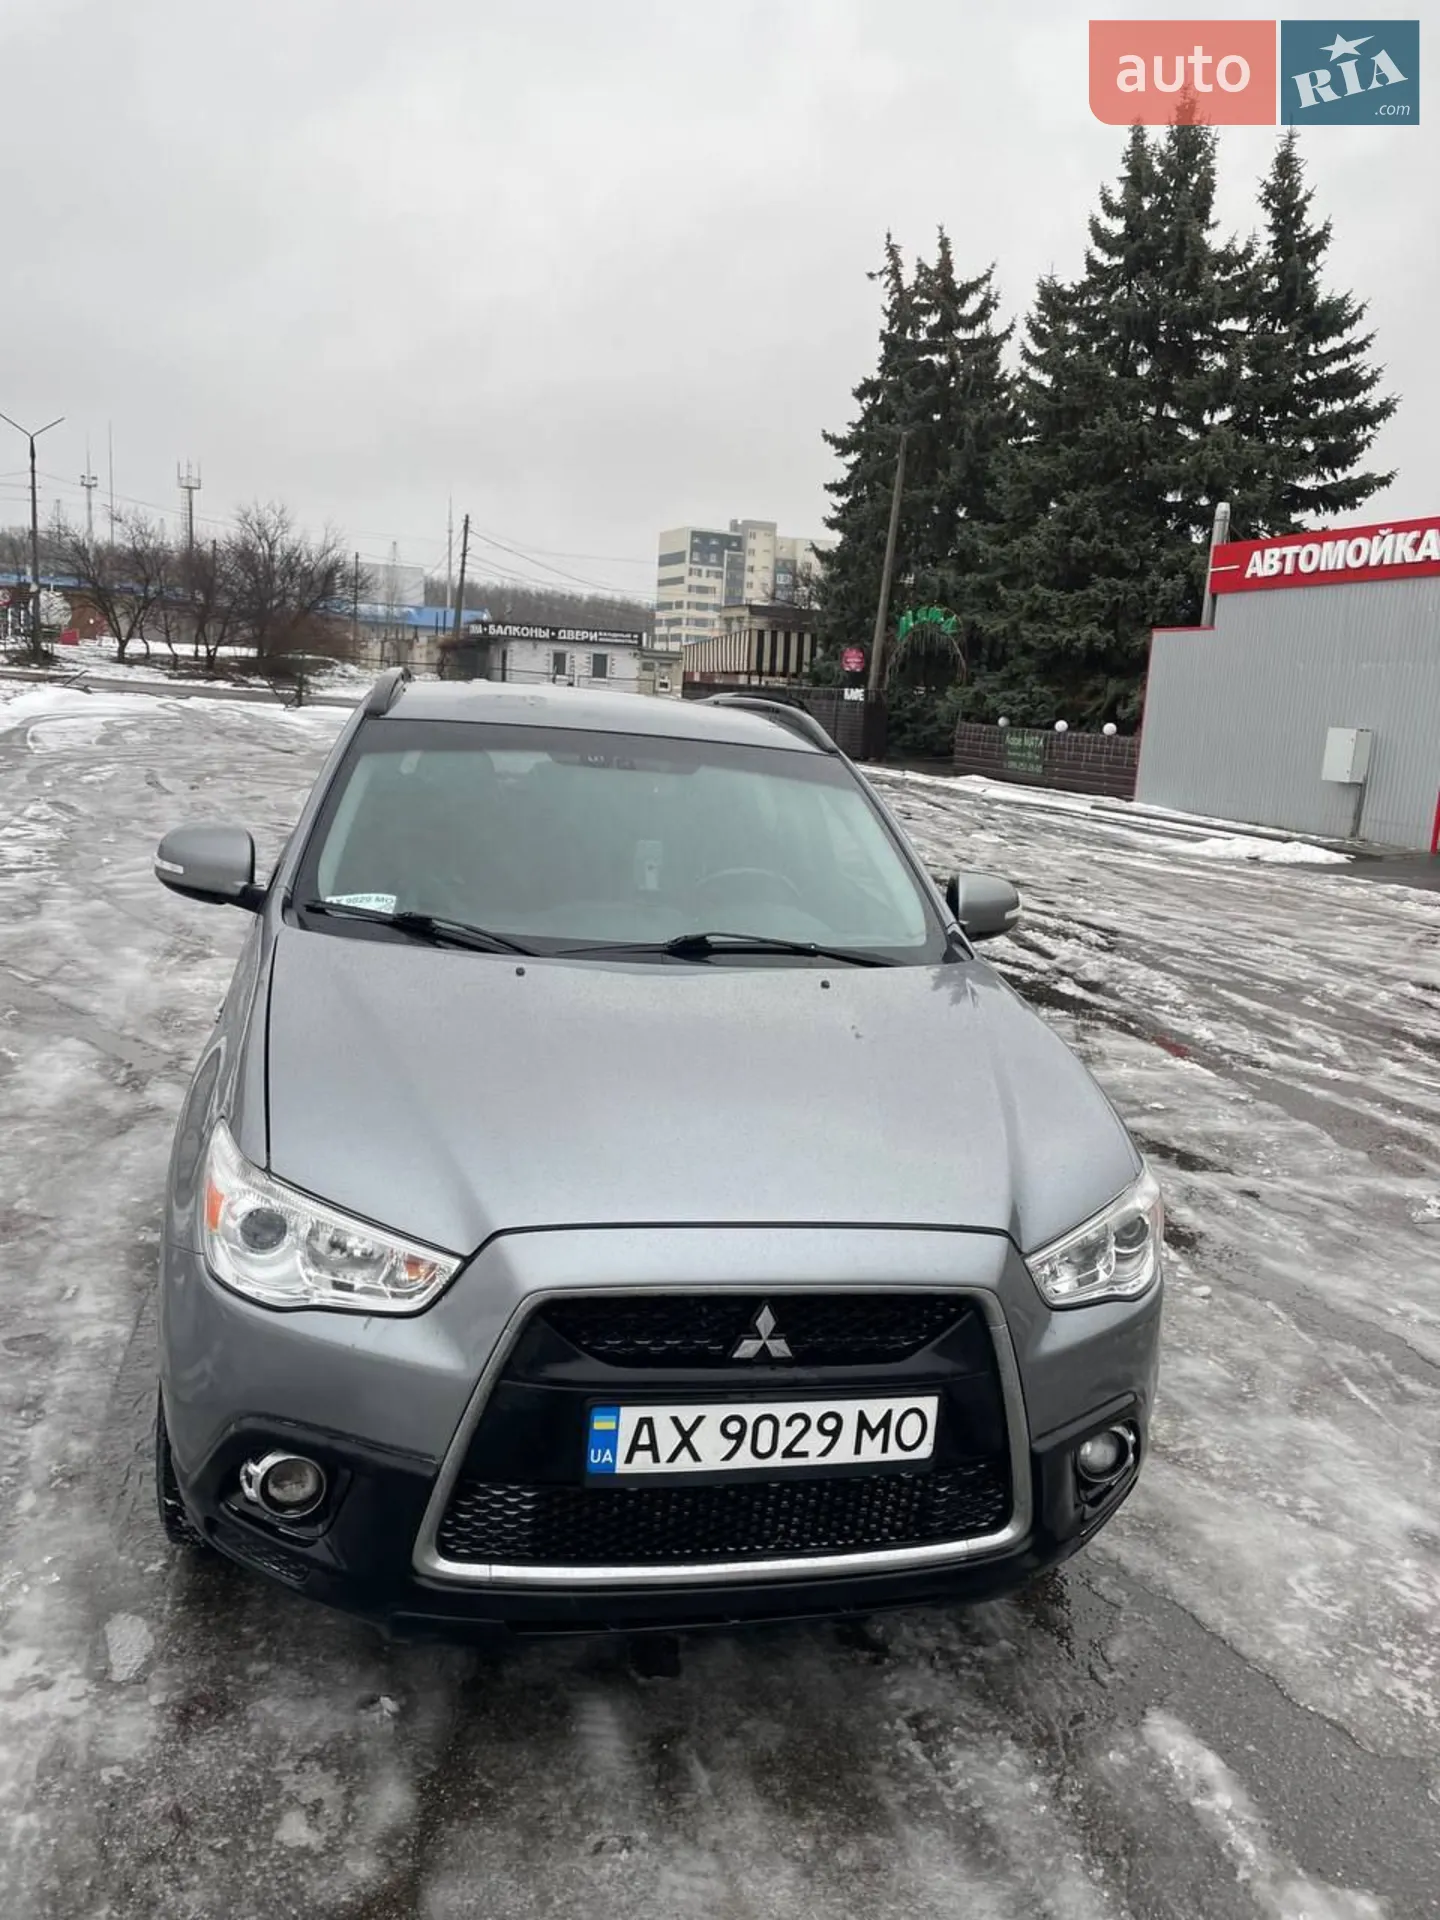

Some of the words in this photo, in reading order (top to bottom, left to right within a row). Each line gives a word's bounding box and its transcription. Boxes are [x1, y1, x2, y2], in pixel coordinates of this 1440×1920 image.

[1245, 528, 1440, 579] АВТОМОЙКА
[488, 624, 550, 639] БАЛКОНЫ
[557, 629, 598, 642] ДВЕРИ
[624, 1415, 707, 1464] AX
[719, 1411, 843, 1462] 9029
[853, 1406, 929, 1456] MO
[589, 1448, 613, 1464] UA
